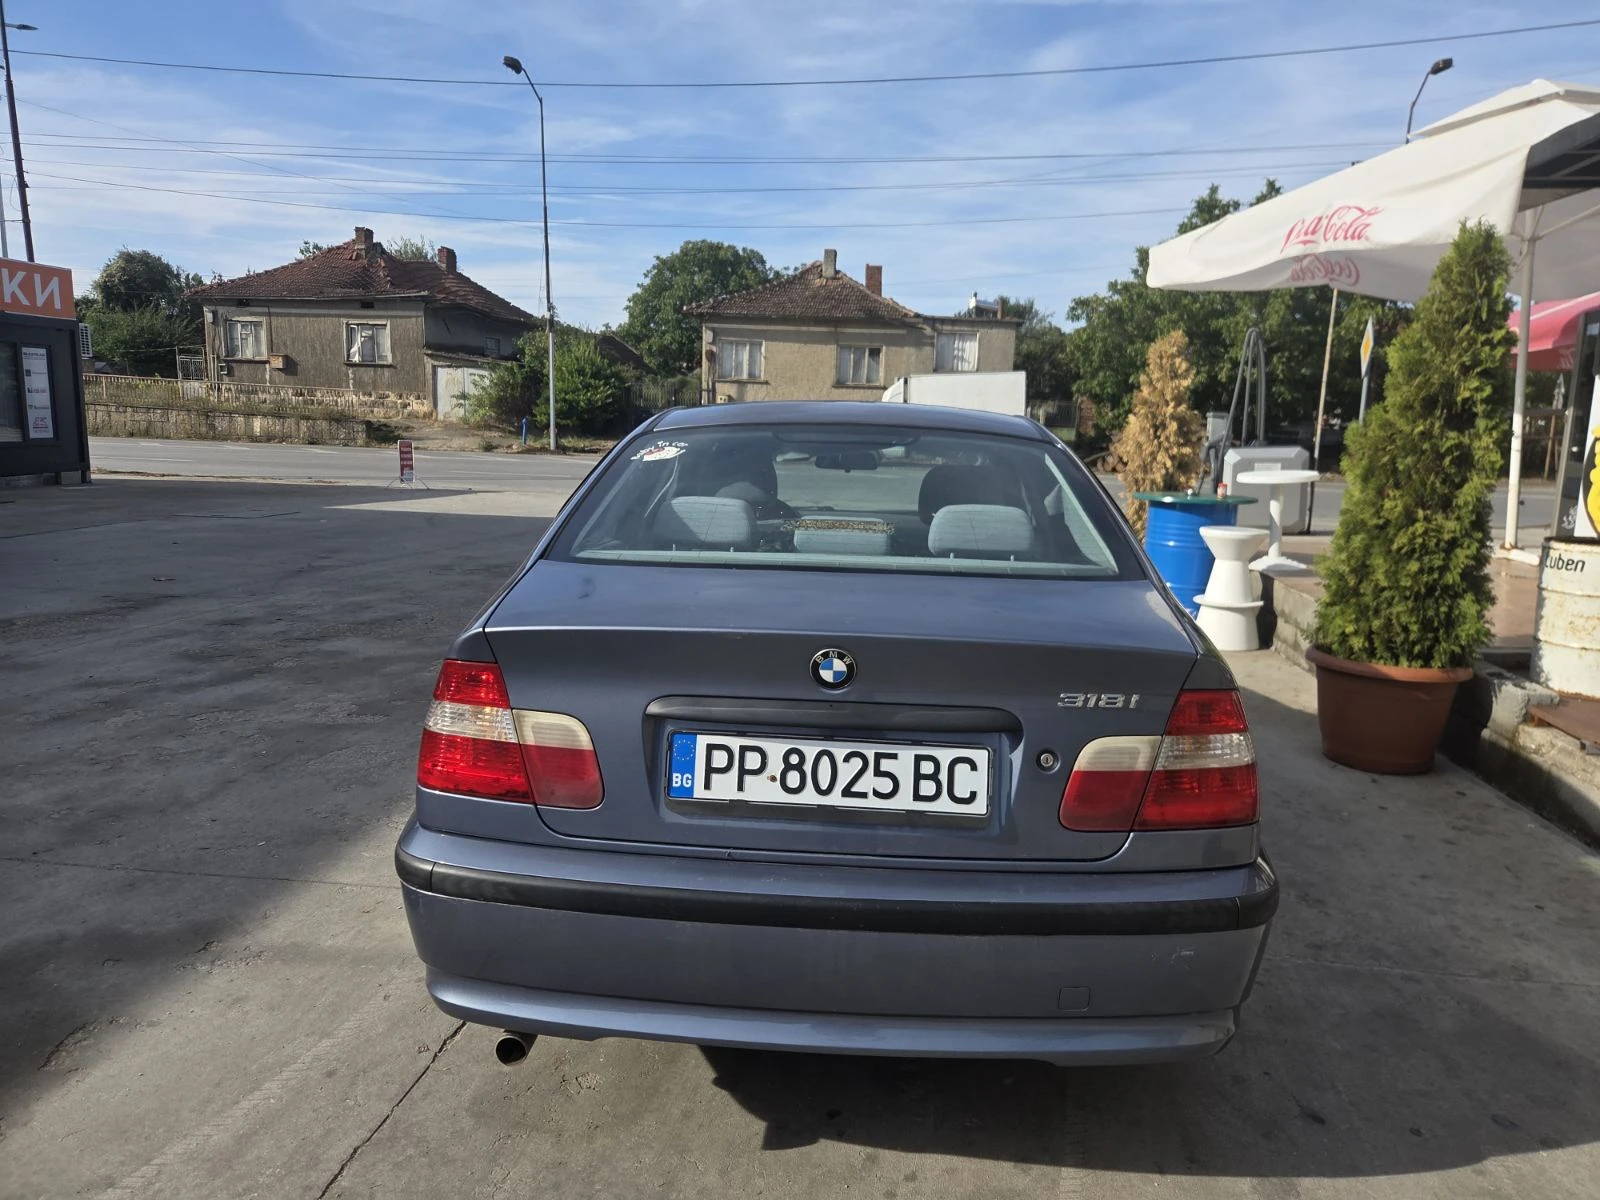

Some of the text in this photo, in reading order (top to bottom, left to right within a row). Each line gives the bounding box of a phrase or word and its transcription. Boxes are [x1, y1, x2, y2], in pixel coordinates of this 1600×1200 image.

[815, 650, 853, 665] BMW
[1057, 693, 1140, 709] 318i
[672, 773, 692, 788] BG
[703, 742, 979, 806] PP 8025 BC
